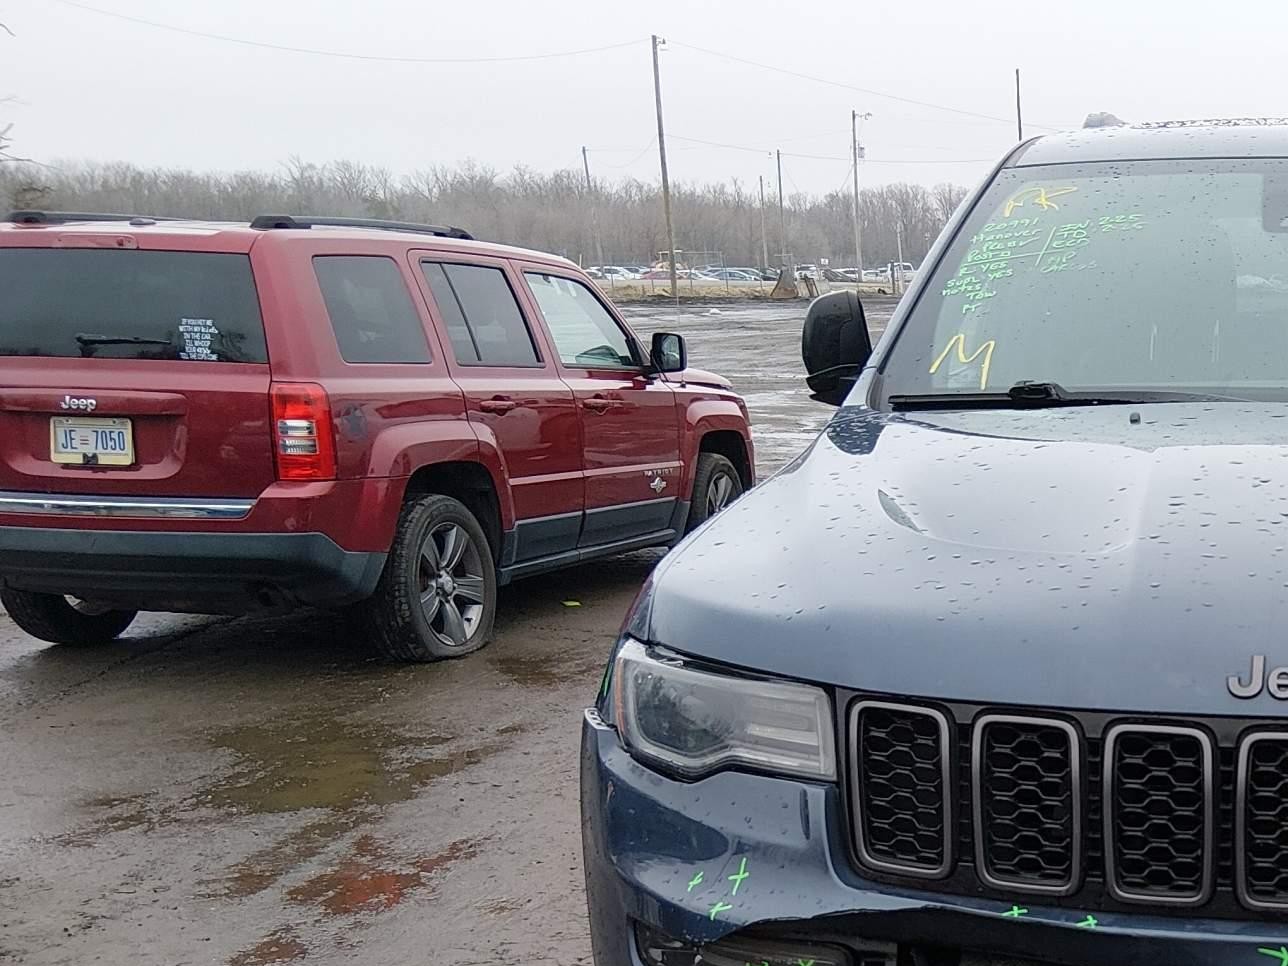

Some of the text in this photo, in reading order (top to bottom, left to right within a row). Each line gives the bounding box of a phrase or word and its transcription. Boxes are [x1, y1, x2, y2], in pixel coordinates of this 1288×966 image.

[60, 395, 97, 412] Jeep
[61, 429, 126, 451] JE 7050
